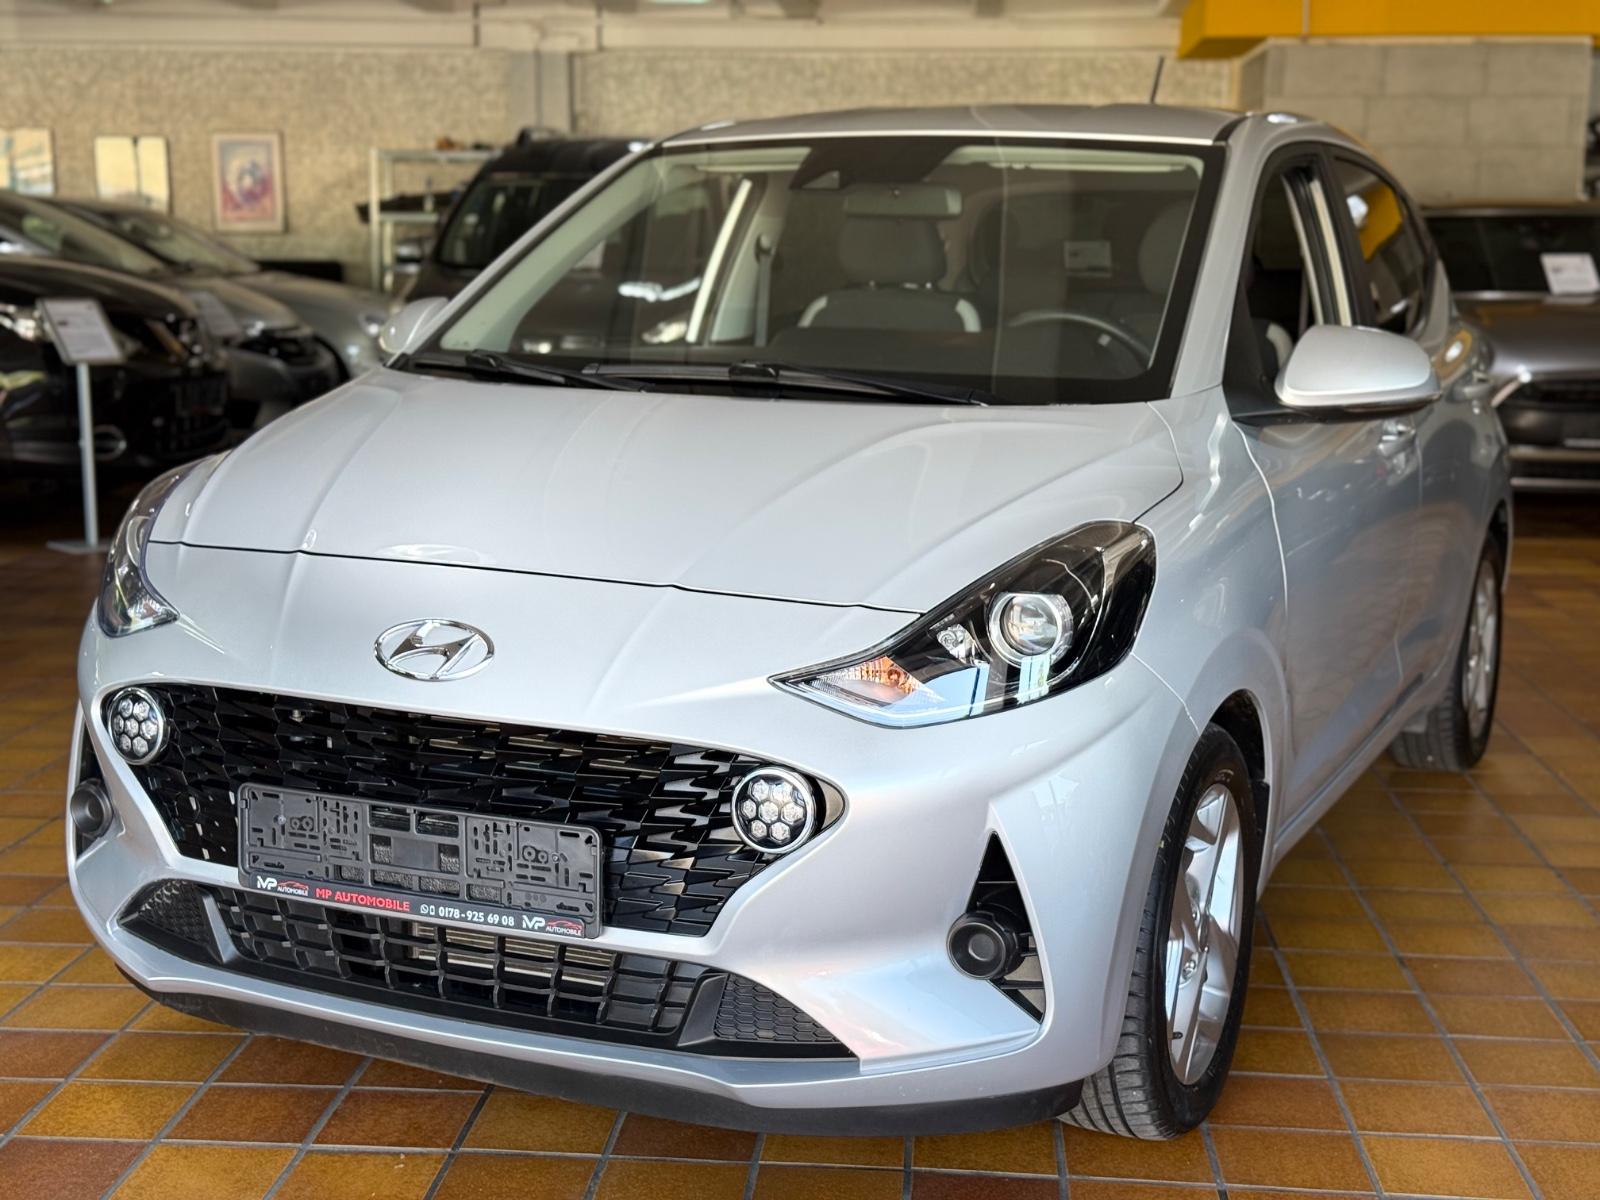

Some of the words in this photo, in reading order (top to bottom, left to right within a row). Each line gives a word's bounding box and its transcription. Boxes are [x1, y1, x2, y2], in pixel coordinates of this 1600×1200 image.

[256, 876, 277, 890] MP
[277, 886, 309, 897] AUTOMOBILE
[315, 888, 332, 899] MP
[334, 891, 410, 912] AUTOMOBILE
[487, 912, 499, 924] 69
[501, 915, 515, 927] 08
[522, 914, 546, 930] MP
[545, 925, 582, 936] AUTOMOBILE
